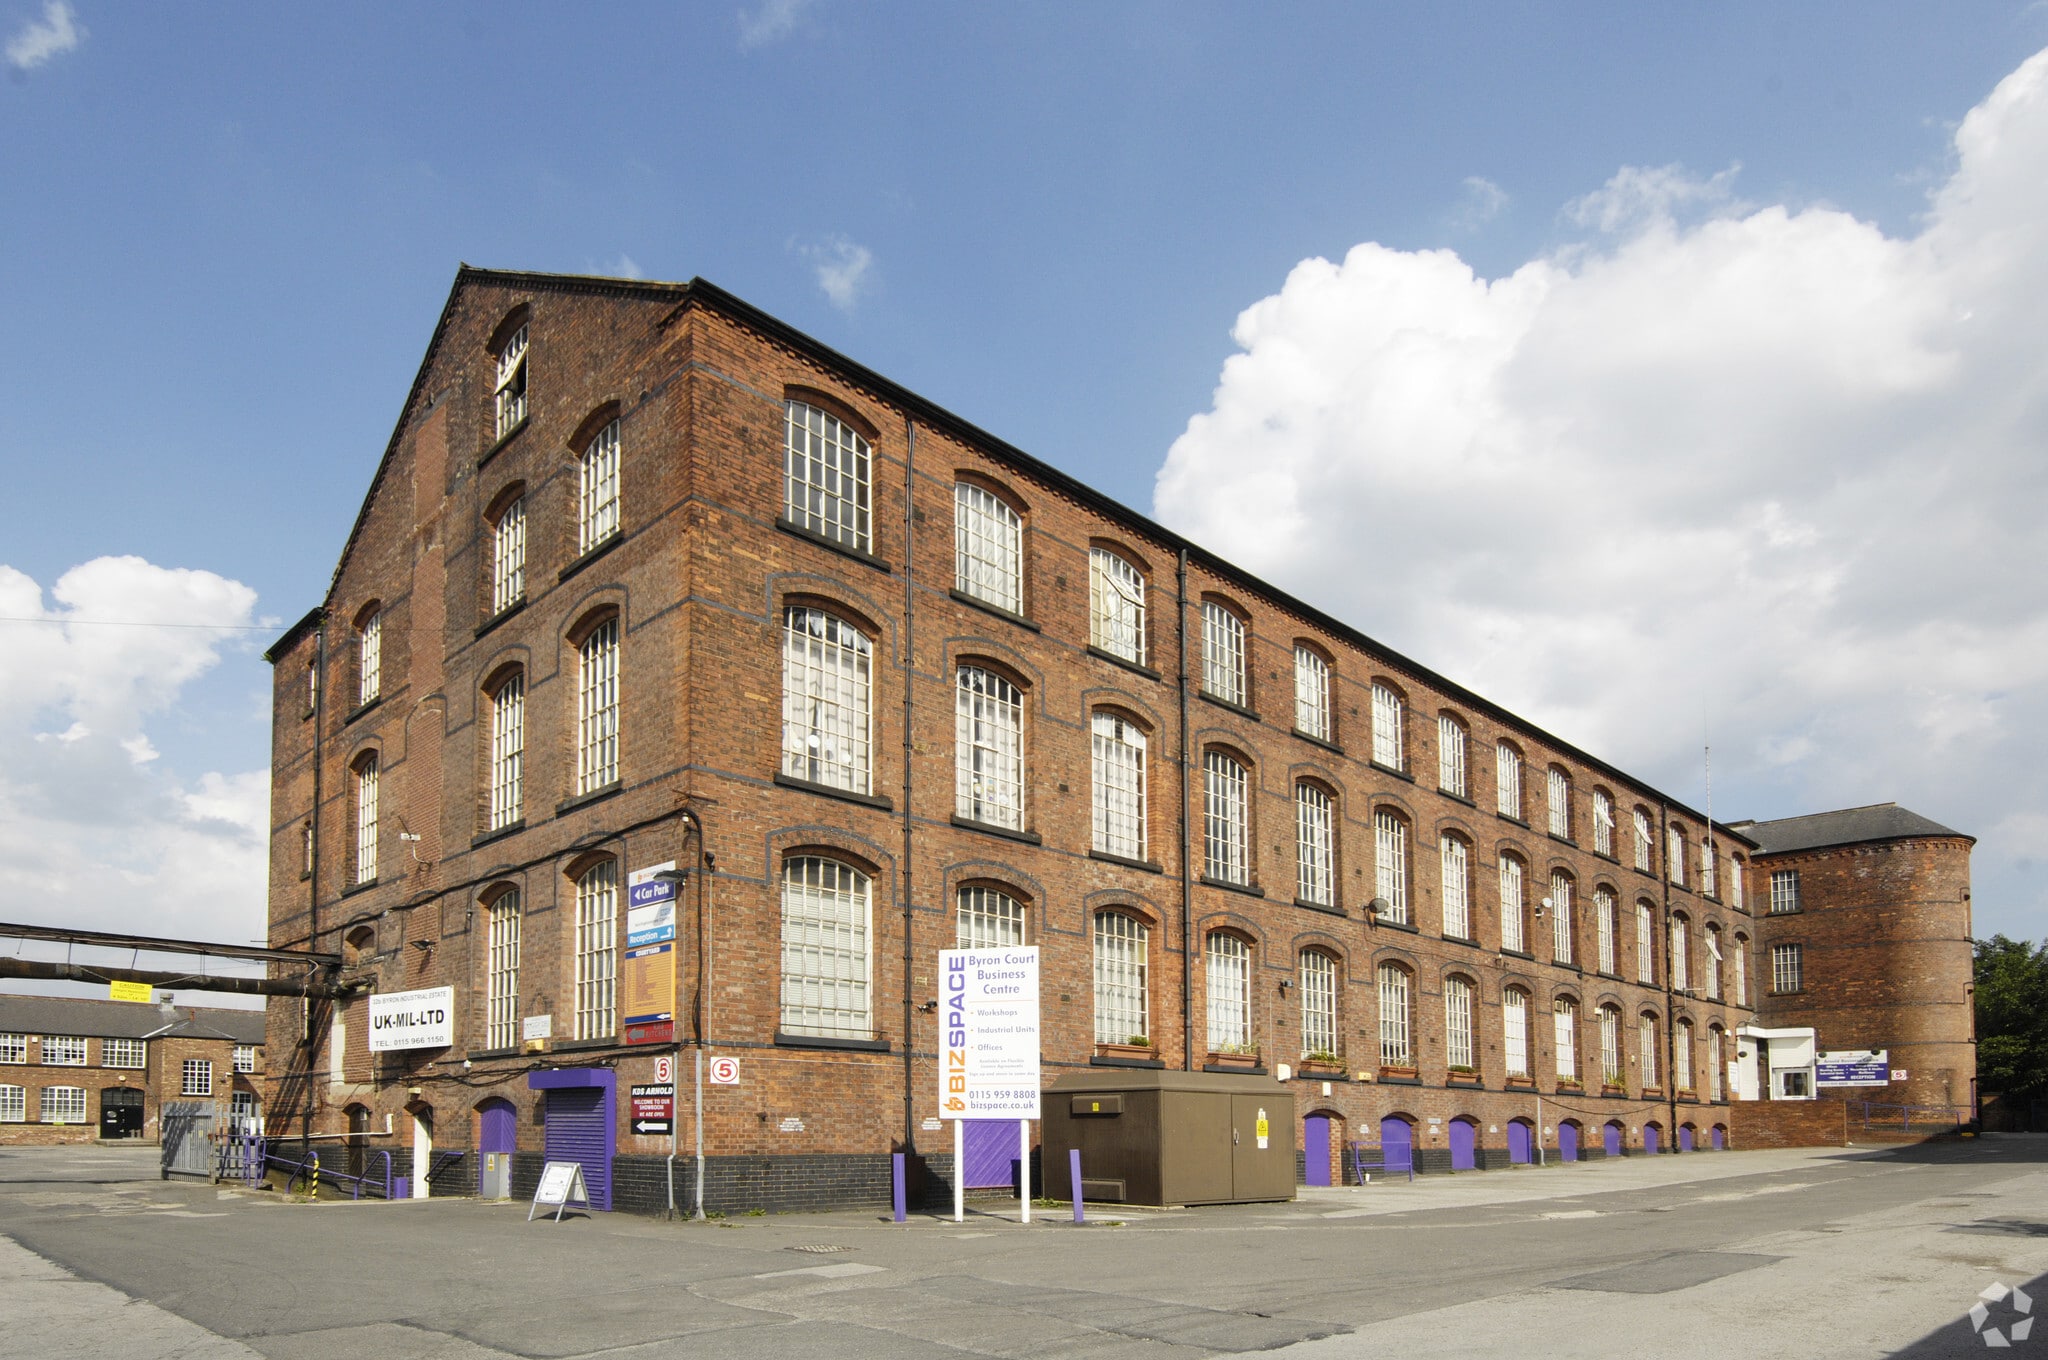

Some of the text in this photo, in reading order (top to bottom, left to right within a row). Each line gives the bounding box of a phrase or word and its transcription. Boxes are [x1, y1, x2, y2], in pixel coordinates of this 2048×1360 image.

[641, 882, 669, 899] Car Park
[630, 932, 658, 944] Reception
[969, 954, 1034, 968] Byron Court
[978, 970, 1026, 980] Business
[983, 984, 1020, 994] Centre
[949, 956, 965, 1093] BIZSPACE
[660, 1063, 667, 1077] 5
[719, 1064, 732, 1077] 5
[645, 1087, 673, 1095] ARNOLD
[969, 1090, 1036, 1099] 0115 959 8808
[970, 1100, 1034, 1111] bizspace.co.uk
